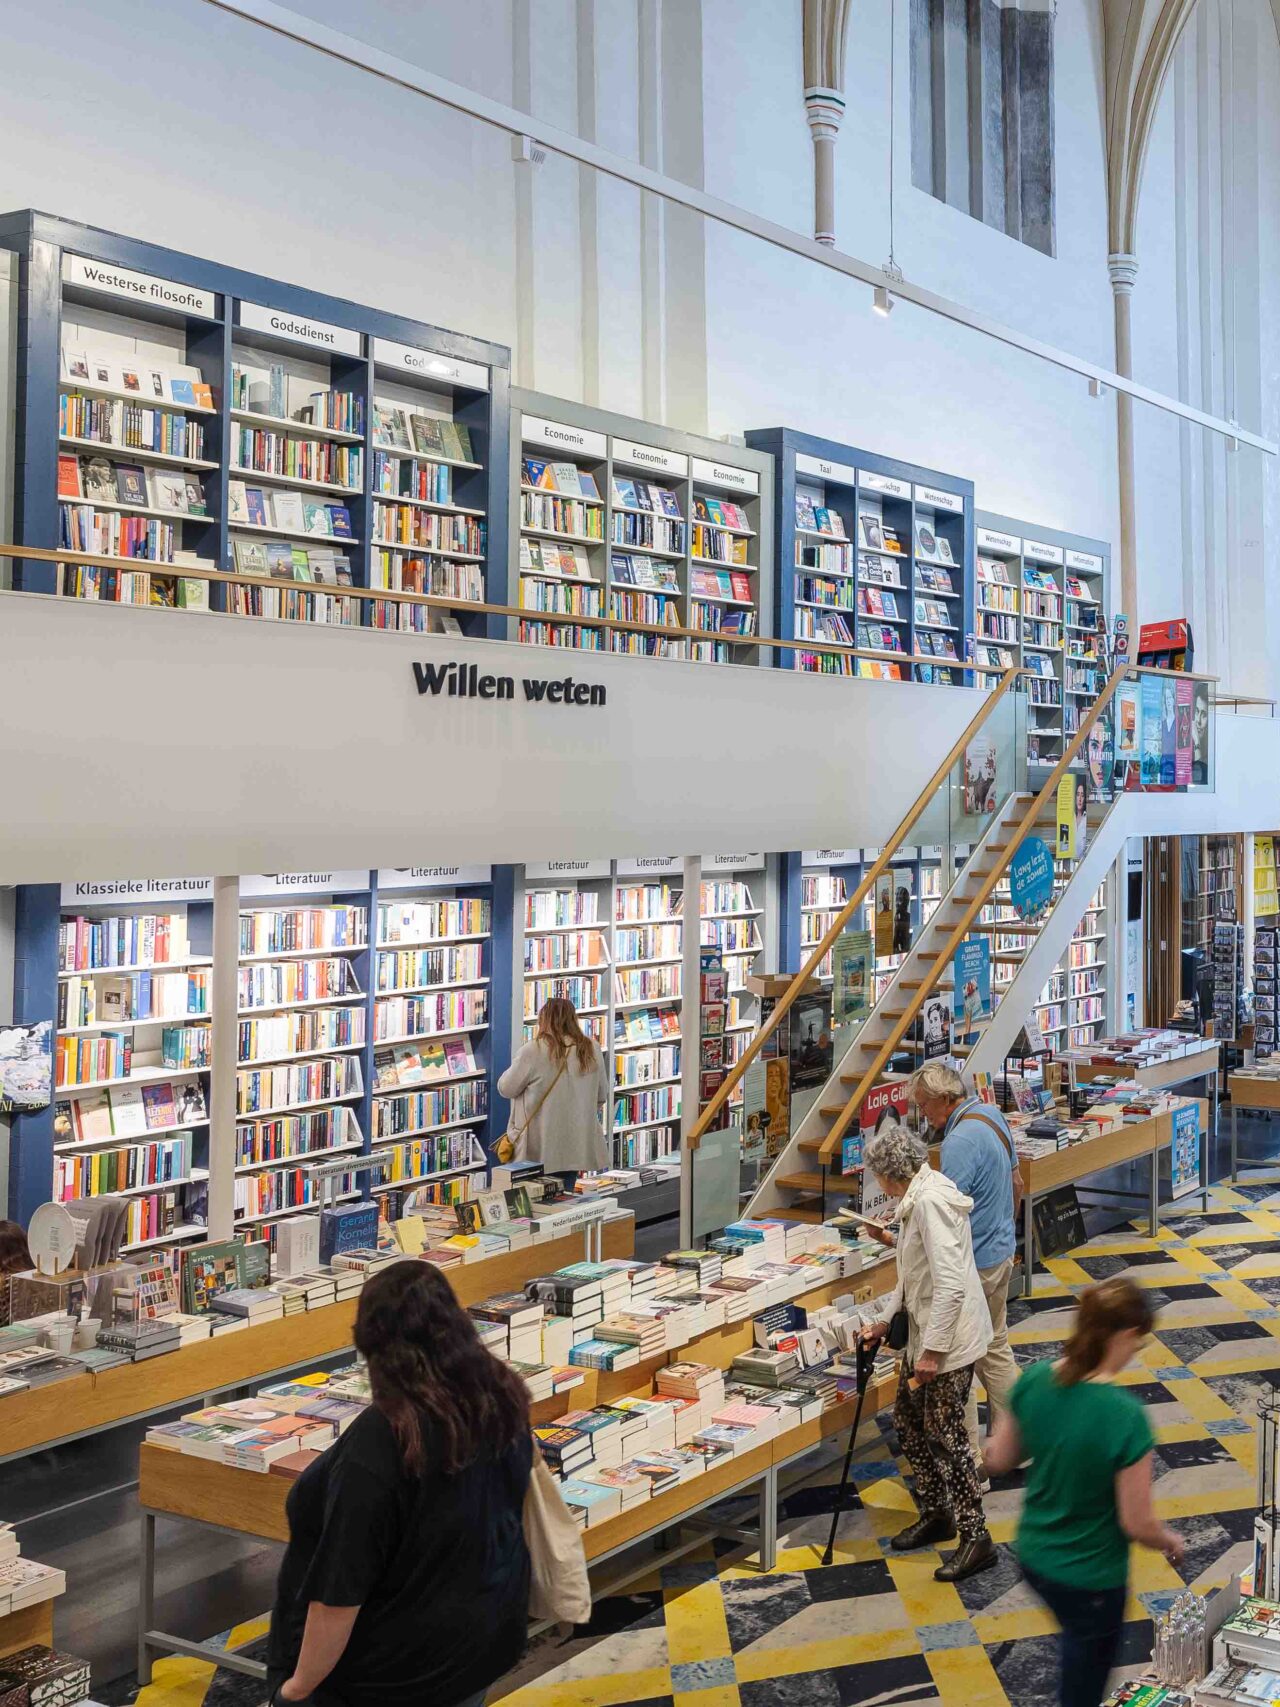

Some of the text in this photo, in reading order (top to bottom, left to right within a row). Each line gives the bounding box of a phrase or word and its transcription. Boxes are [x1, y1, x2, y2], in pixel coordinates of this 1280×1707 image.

[84, 266, 203, 309] Westerse filosofie
[270, 317, 335, 344] Godsdienst
[404, 354, 460, 378] Godst
[544, 427, 584, 445] Economie
[632, 449, 668, 466] Economie
[713, 469, 745, 485] Economie
[819, 464, 832, 475] Taal
[412, 661, 607, 706] Willen weten
[548, 861, 589, 871] Literatuur
[636, 857, 673, 867] Literatuur
[714, 854, 748, 864] Literatuur
[275, 873, 332, 885] Literatuur
[411, 866, 459, 878] Literatuur
[75, 878, 211, 896] Klassieke literatuur
[867, 1093, 889, 1110] Lale
[318, 1166, 345, 1176] Literatuur
[865, 1193, 888, 1211] IK BEN
[340, 1209, 375, 1228] Gerard
[552, 1213, 583, 1228] Nederlandse
[338, 1224, 377, 1241] Kornelis
